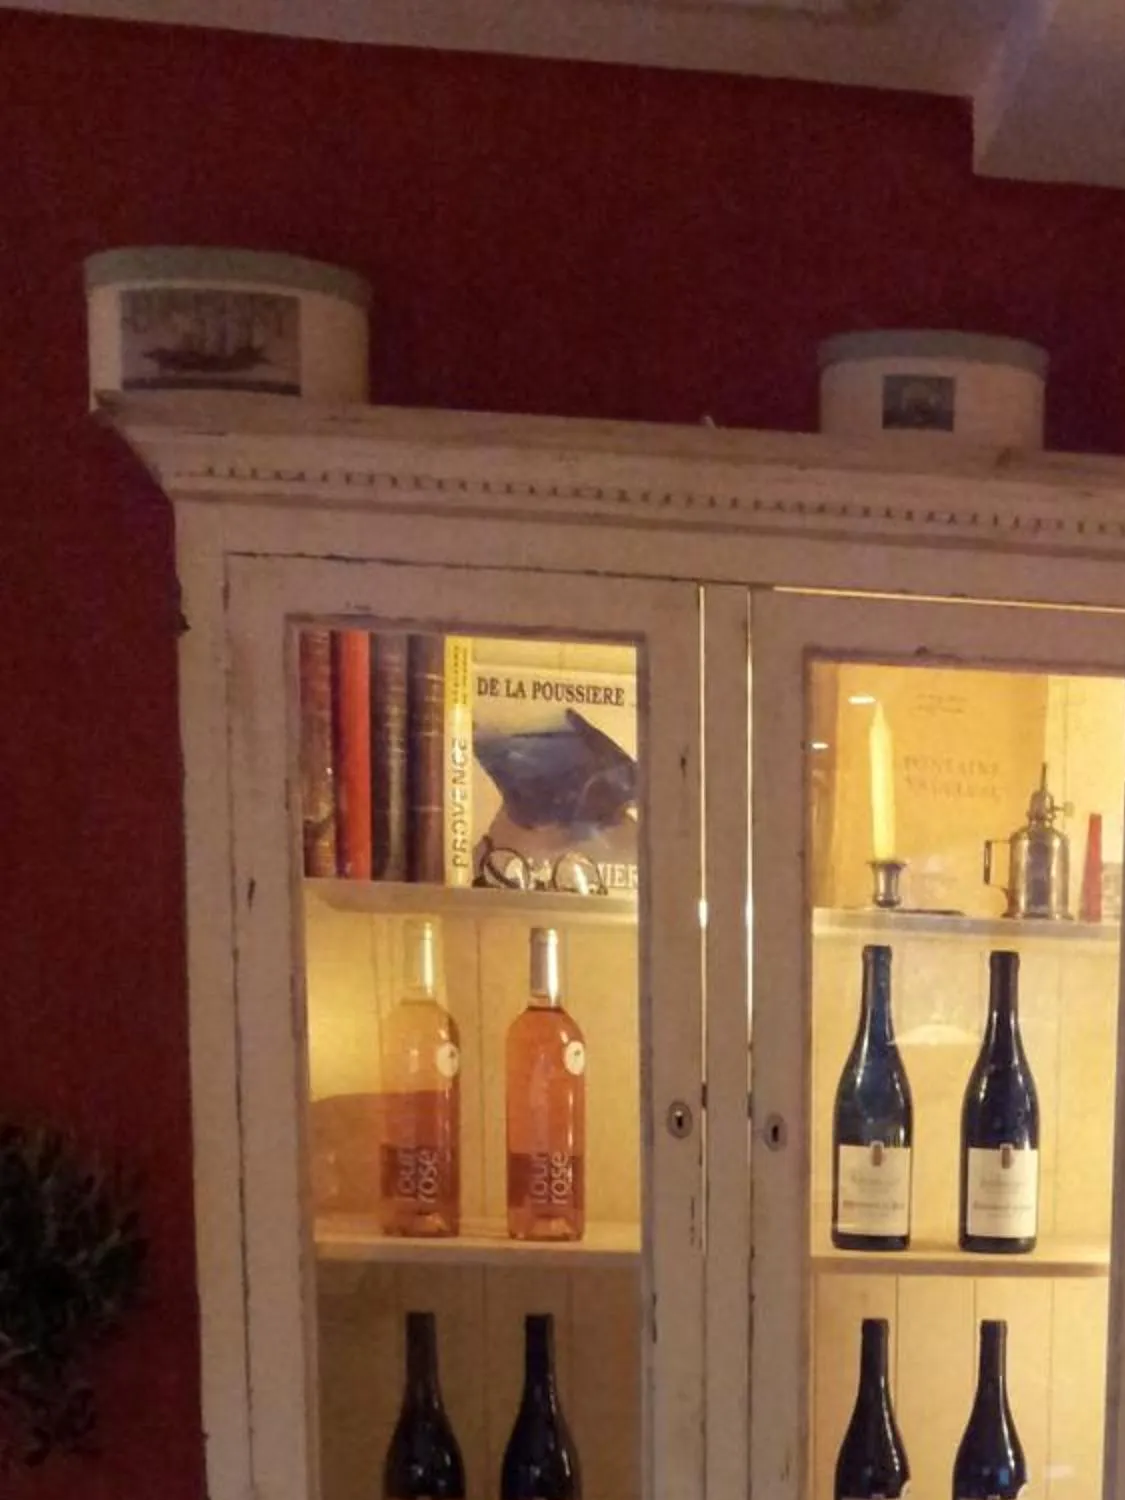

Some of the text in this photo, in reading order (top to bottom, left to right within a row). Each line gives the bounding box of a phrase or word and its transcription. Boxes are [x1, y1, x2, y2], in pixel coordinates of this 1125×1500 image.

[477, 677, 499, 697] DE
[505, 679, 526, 699] LA
[451, 737, 469, 868] PROVENCE
